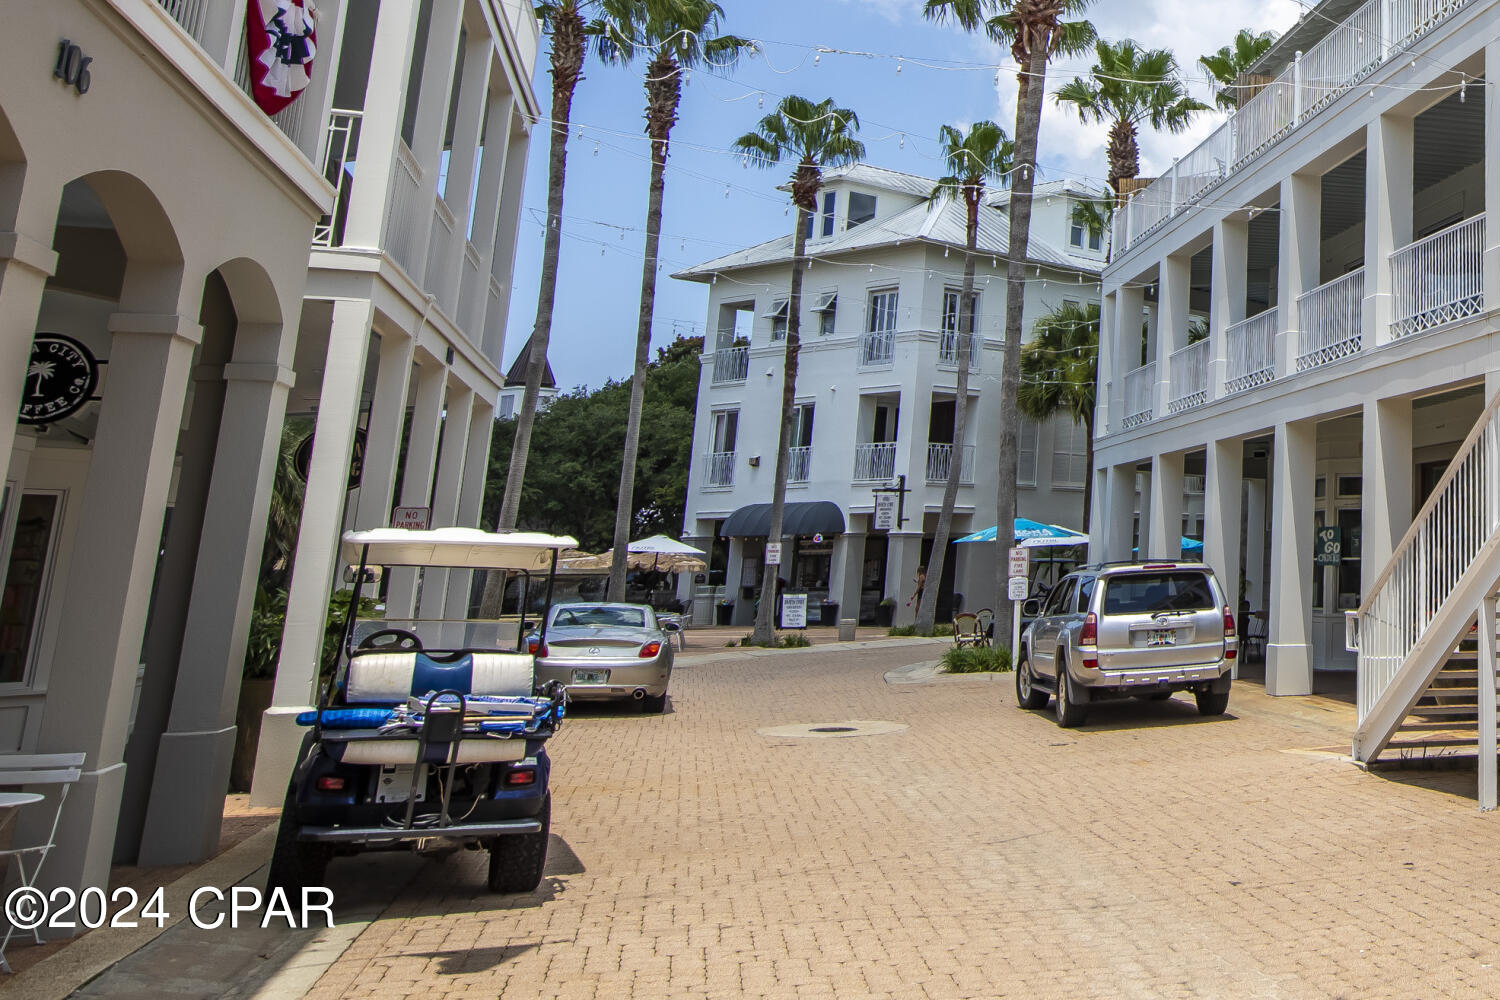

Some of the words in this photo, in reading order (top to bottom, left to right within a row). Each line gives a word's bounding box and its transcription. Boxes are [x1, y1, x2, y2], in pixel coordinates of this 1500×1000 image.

[55, 39, 93, 95] 106
[49, 343, 85, 368] CITY
[22, 396, 68, 414] FFEE
[405, 511, 418, 519] NO
[396, 520, 426, 530] PARKING
[1319, 529, 1334, 542] TO
[1324, 541, 1341, 554] GO
